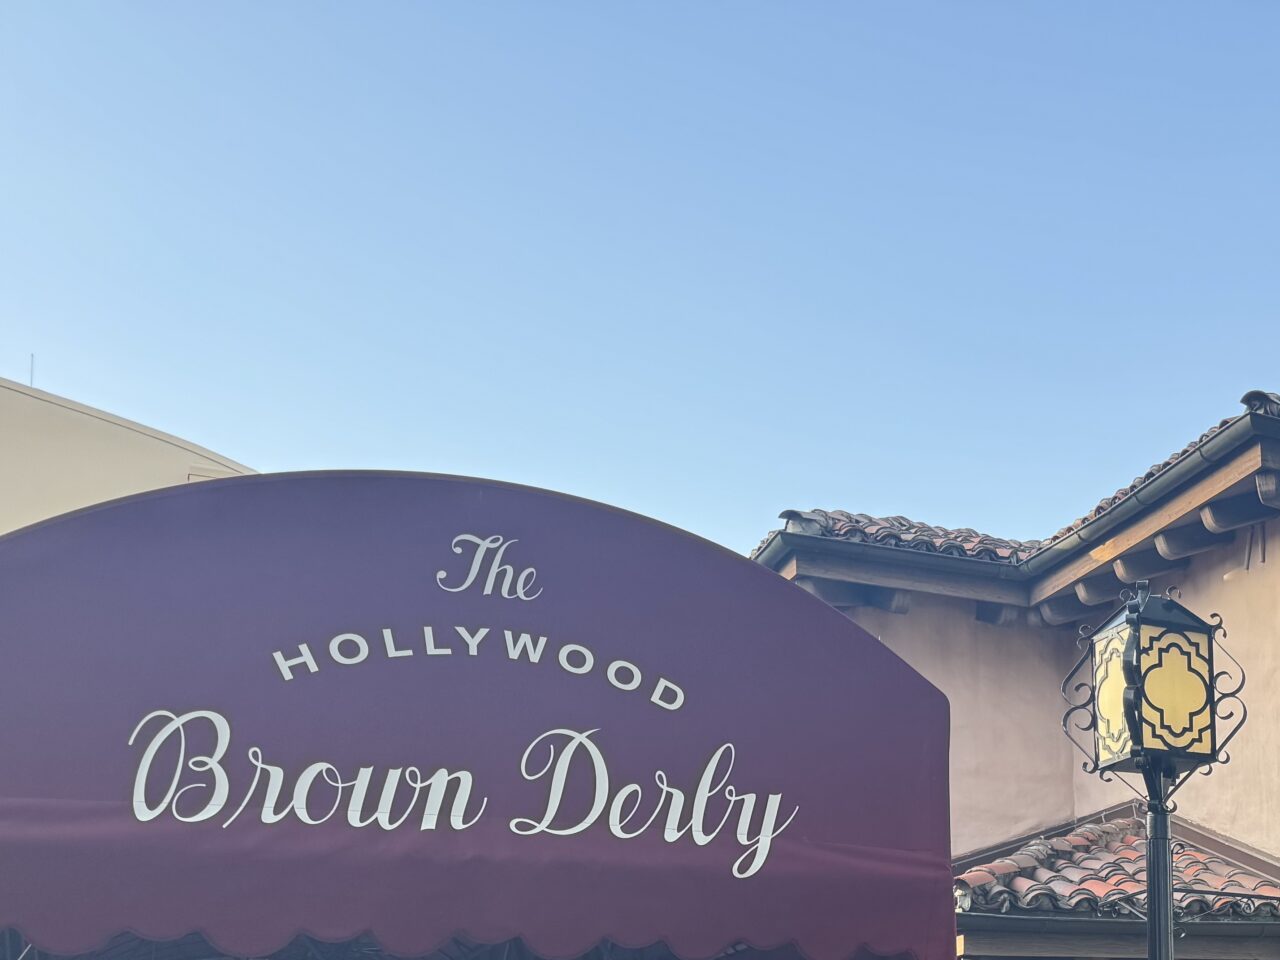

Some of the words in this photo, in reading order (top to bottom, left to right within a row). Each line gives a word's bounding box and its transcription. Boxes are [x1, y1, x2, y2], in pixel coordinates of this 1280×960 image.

[436, 534, 543, 600] The
[272, 626, 685, 710] HOLLYWOOD
[128, 710, 487, 830] Brown
[509, 728, 799, 878] Derby
